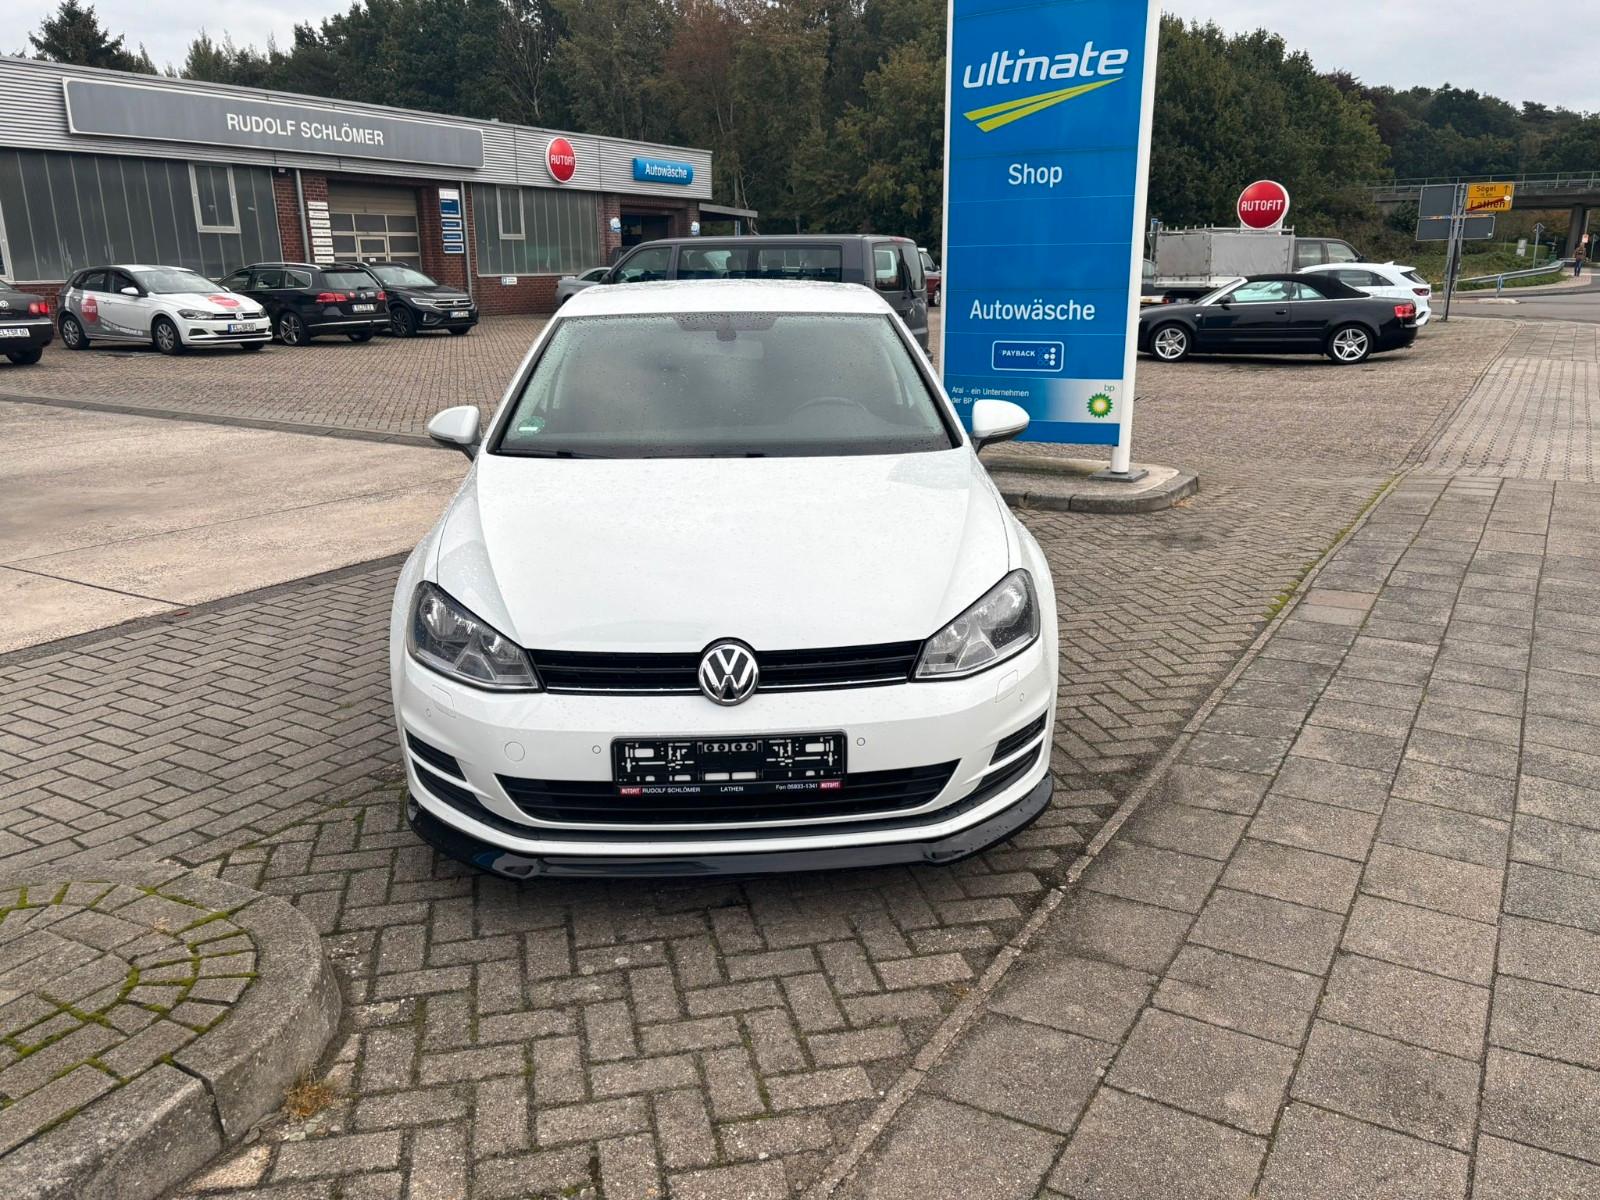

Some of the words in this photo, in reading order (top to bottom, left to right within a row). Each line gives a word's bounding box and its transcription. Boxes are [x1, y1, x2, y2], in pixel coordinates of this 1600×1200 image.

[962, 41, 1129, 89] ultimate
[226, 113, 296, 136] RUDOLF
[300, 121, 384, 146] SCHLÖMER
[644, 162, 688, 179] Autowäsche
[1008, 163, 1063, 188] Shop
[1240, 199, 1283, 212] AUTOFIT
[969, 298, 1096, 321] Autowäsche
[1002, 349, 1036, 357] PAYBACK
[951, 386, 964, 394] Aral
[970, 387, 981, 395] ein
[982, 387, 1030, 397] Unternehmen
[1104, 383, 1116, 393] bp
[963, 397, 973, 405] BP
